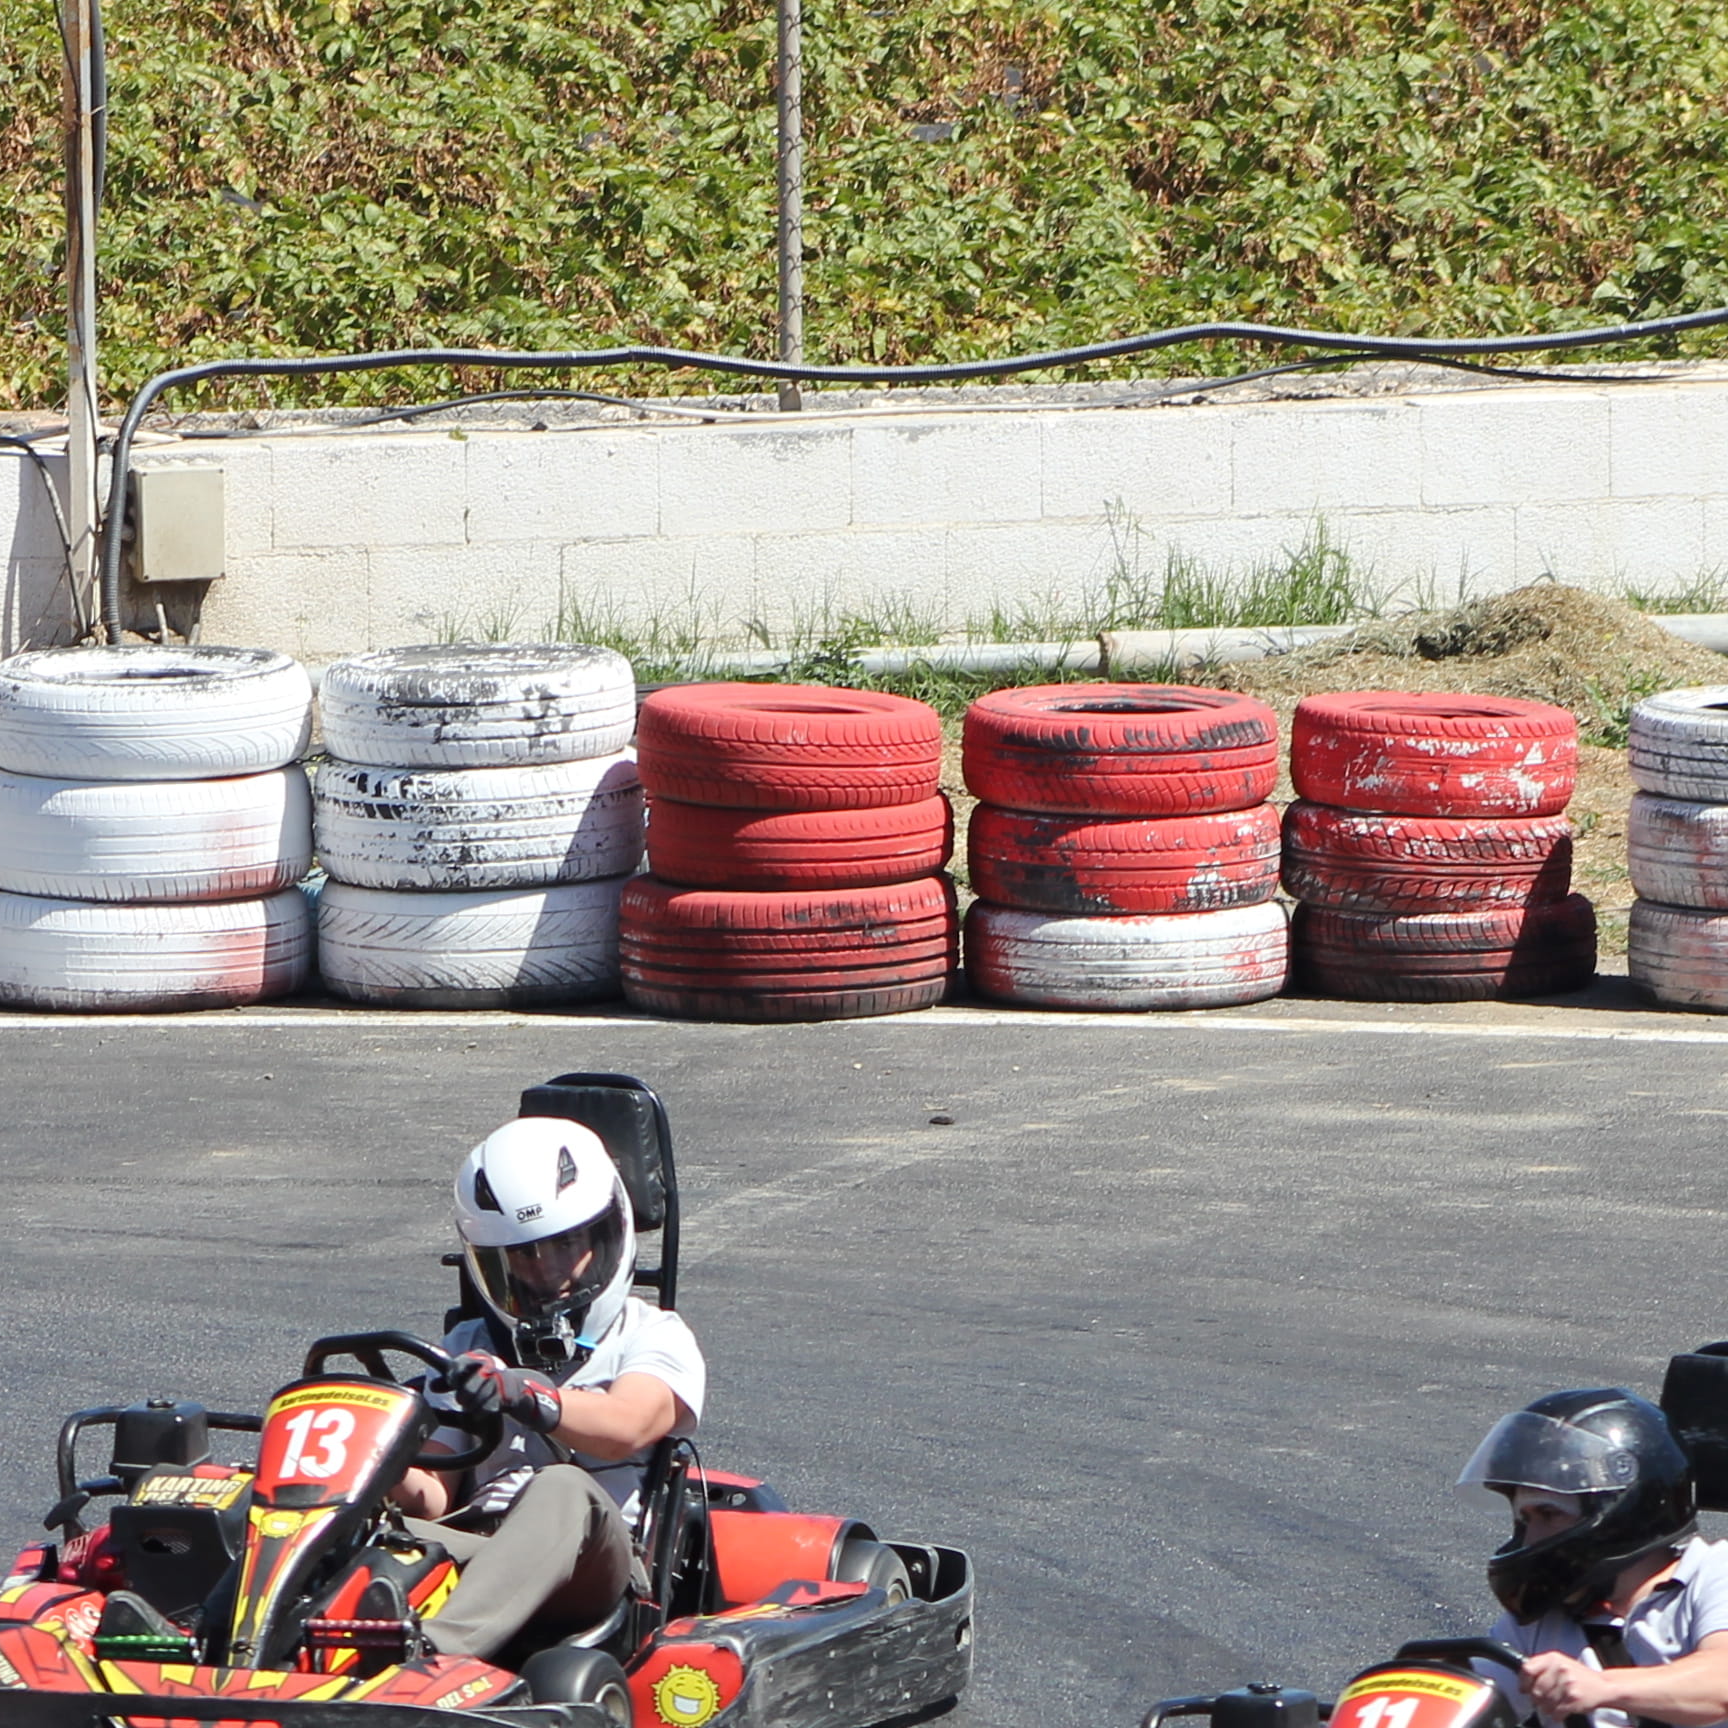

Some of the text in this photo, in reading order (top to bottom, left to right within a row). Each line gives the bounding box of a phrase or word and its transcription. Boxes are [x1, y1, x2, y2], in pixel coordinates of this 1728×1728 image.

[516, 1206, 543, 1221] OMP
[278, 1408, 356, 1479] 13
[146, 1476, 243, 1493] KARTING
